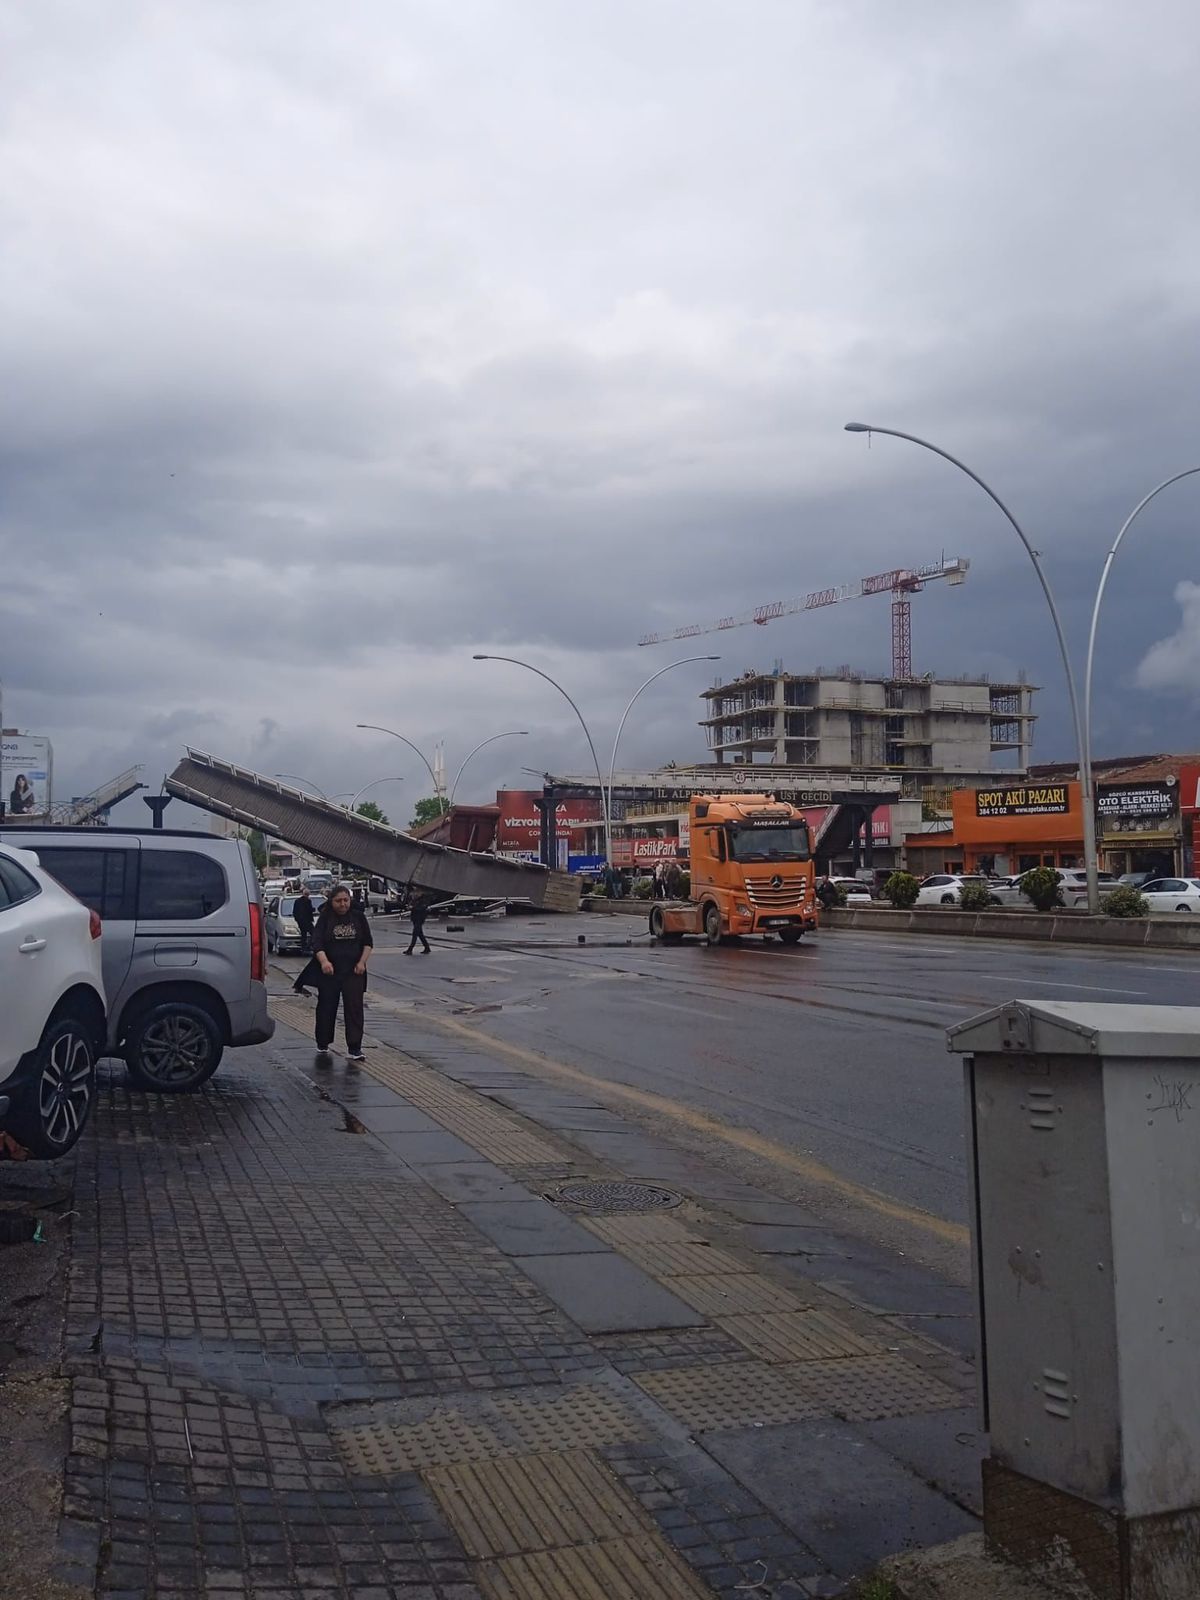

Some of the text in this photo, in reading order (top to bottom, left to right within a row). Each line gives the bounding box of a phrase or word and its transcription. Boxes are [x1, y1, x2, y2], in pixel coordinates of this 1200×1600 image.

[978, 788, 1066, 807] SPOT AKÜ PAZARI
[1098, 793, 1171, 806] OTO ELEKTRİK
[633, 840, 677, 856] LastikPark
